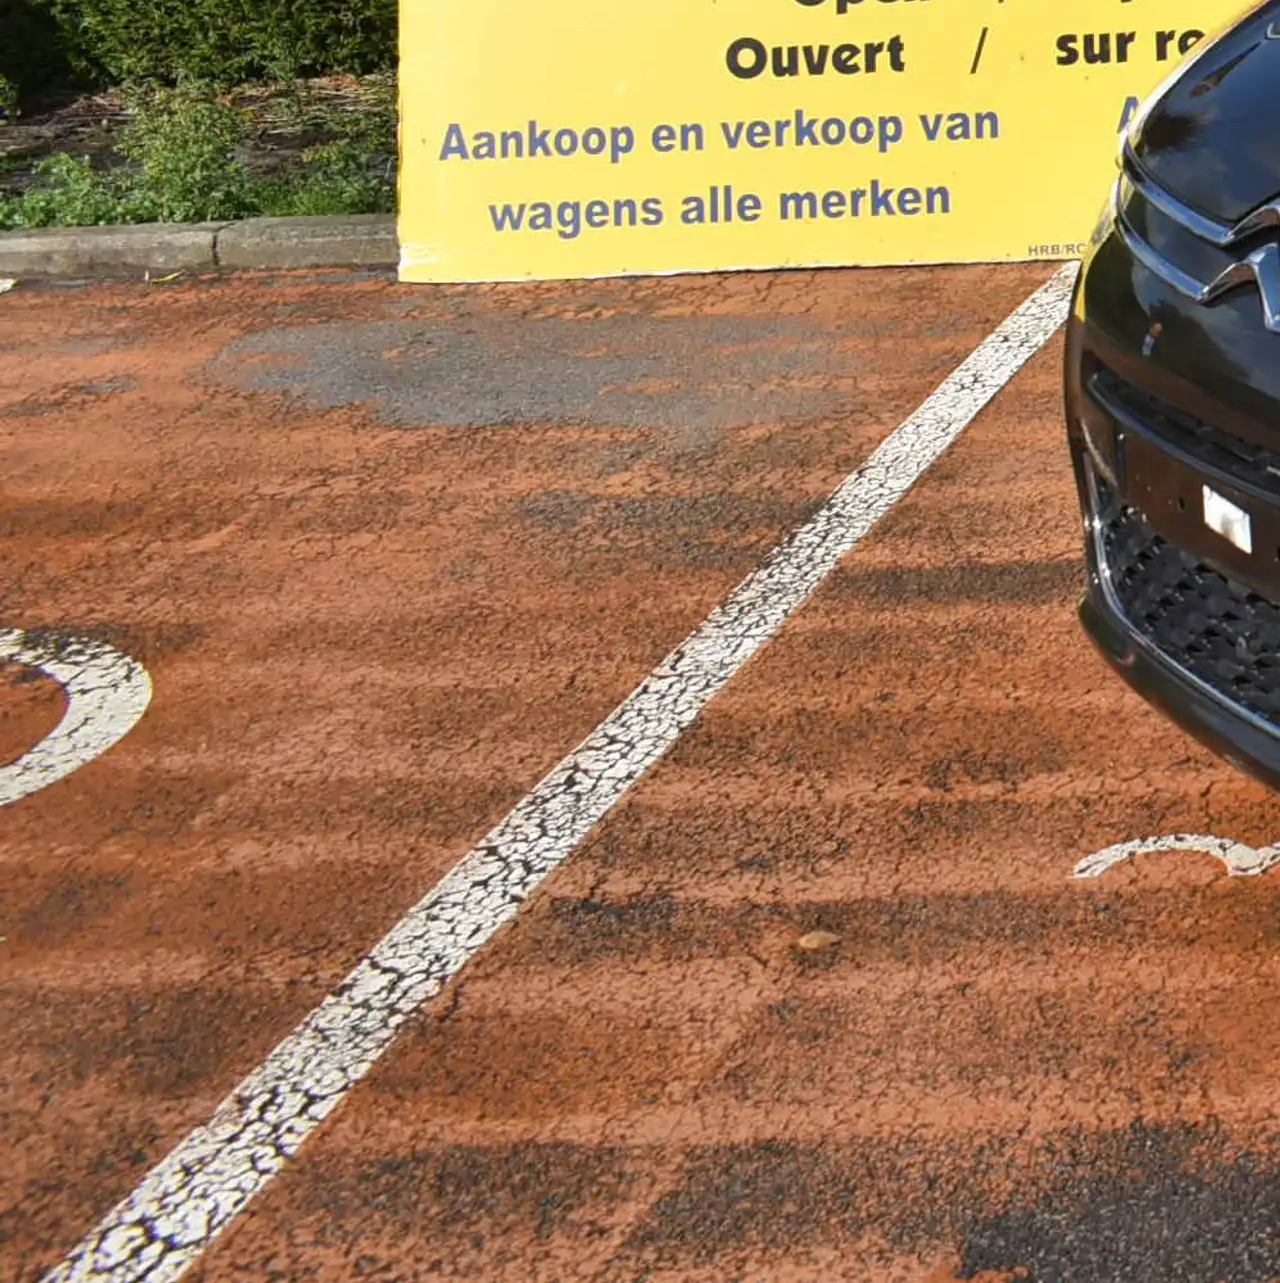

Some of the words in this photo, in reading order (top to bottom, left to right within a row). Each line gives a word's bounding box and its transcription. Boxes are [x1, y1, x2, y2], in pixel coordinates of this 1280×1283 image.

[725, 34, 905, 80] Ouvert
[1056, 31, 1136, 65] sur
[439, 119, 635, 164] Aankoop
[651, 123, 704, 153] en
[721, 109, 903, 153] verkoop
[919, 111, 999, 141] van
[488, 197, 664, 240] wagens
[680, 184, 762, 225] alle
[779, 179, 950, 220] merken
